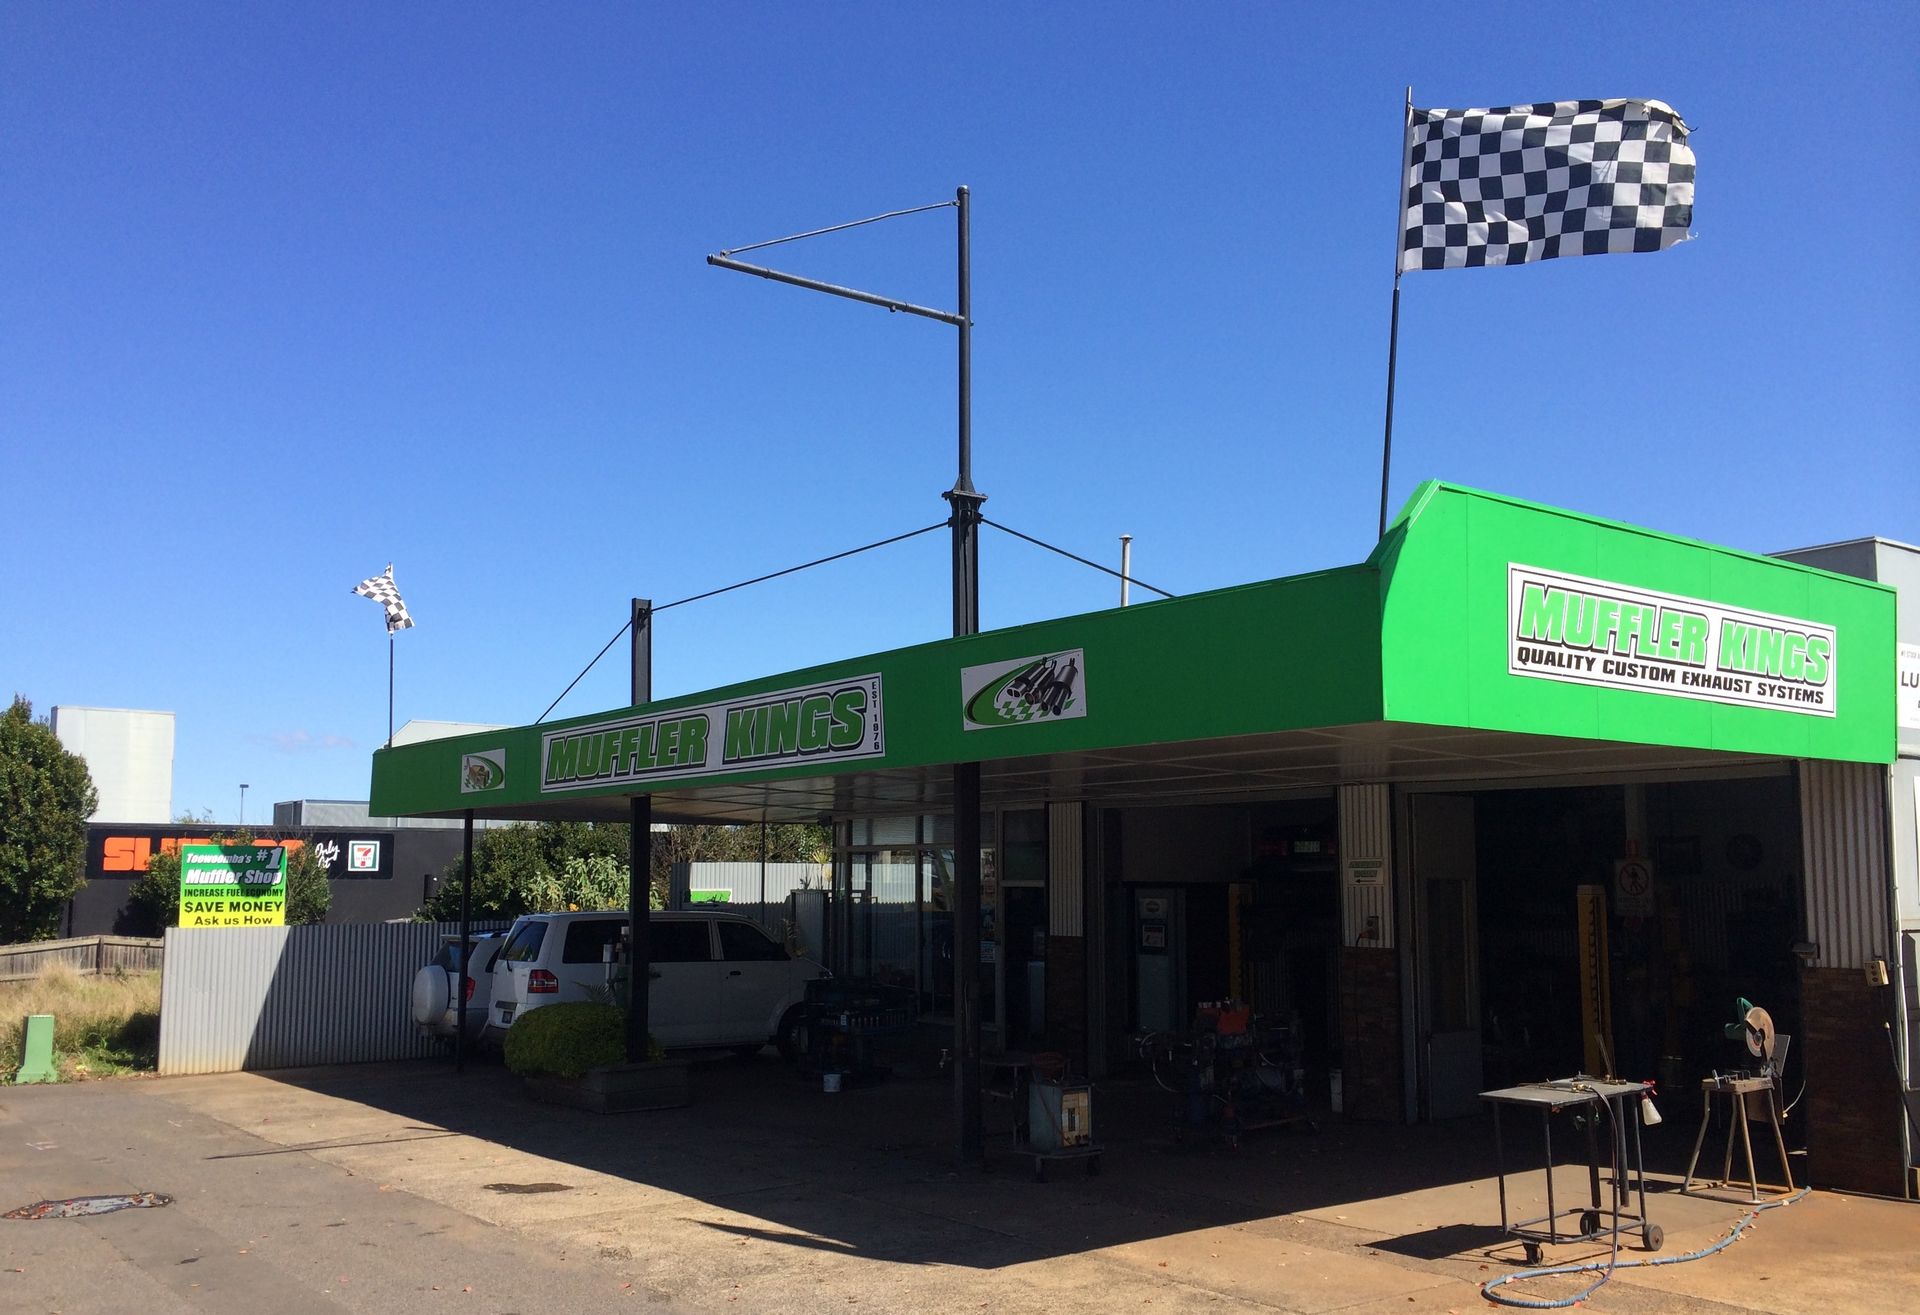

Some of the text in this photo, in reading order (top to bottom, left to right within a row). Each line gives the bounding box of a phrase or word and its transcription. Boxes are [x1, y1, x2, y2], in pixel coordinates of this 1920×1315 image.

[1516, 580, 1831, 688] MUFFLER KINGS
[1517, 646, 1824, 704] QUALITY CUSTOM EXHAUST SYSTEMS
[545, 687, 868, 785] MUFFLER KINGS
[256, 847, 283, 869] #1
[185, 869, 283, 886] Muffler Shop
[184, 888, 283, 897] INCREASE FUEL ECONOMY
[184, 901, 283, 913] $AVE MONEY
[194, 915, 273, 926] Ask us How
